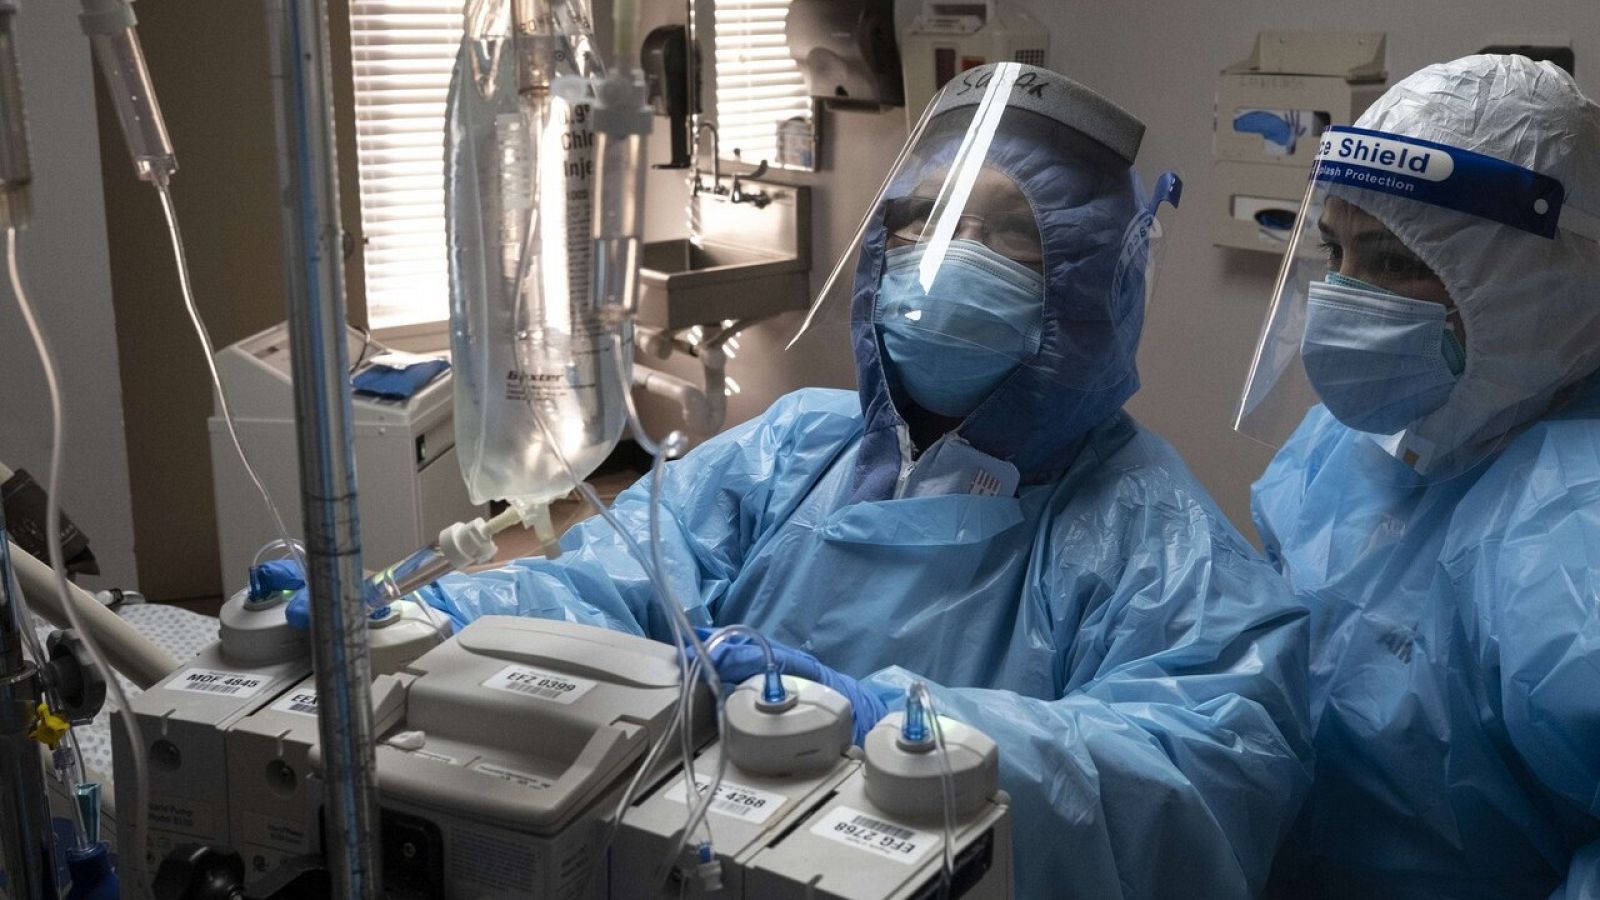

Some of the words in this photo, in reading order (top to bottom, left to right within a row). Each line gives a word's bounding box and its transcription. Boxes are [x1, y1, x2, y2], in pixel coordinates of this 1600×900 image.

[1338, 138, 1431, 174] Shield
[1344, 168, 1415, 193] Protection
[223, 678, 261, 688] 4845
[538, 679, 576, 692] 0399
[726, 792, 766, 808] 4268
[834, 822, 877, 840] 2768
[880, 836, 915, 853] EFG
